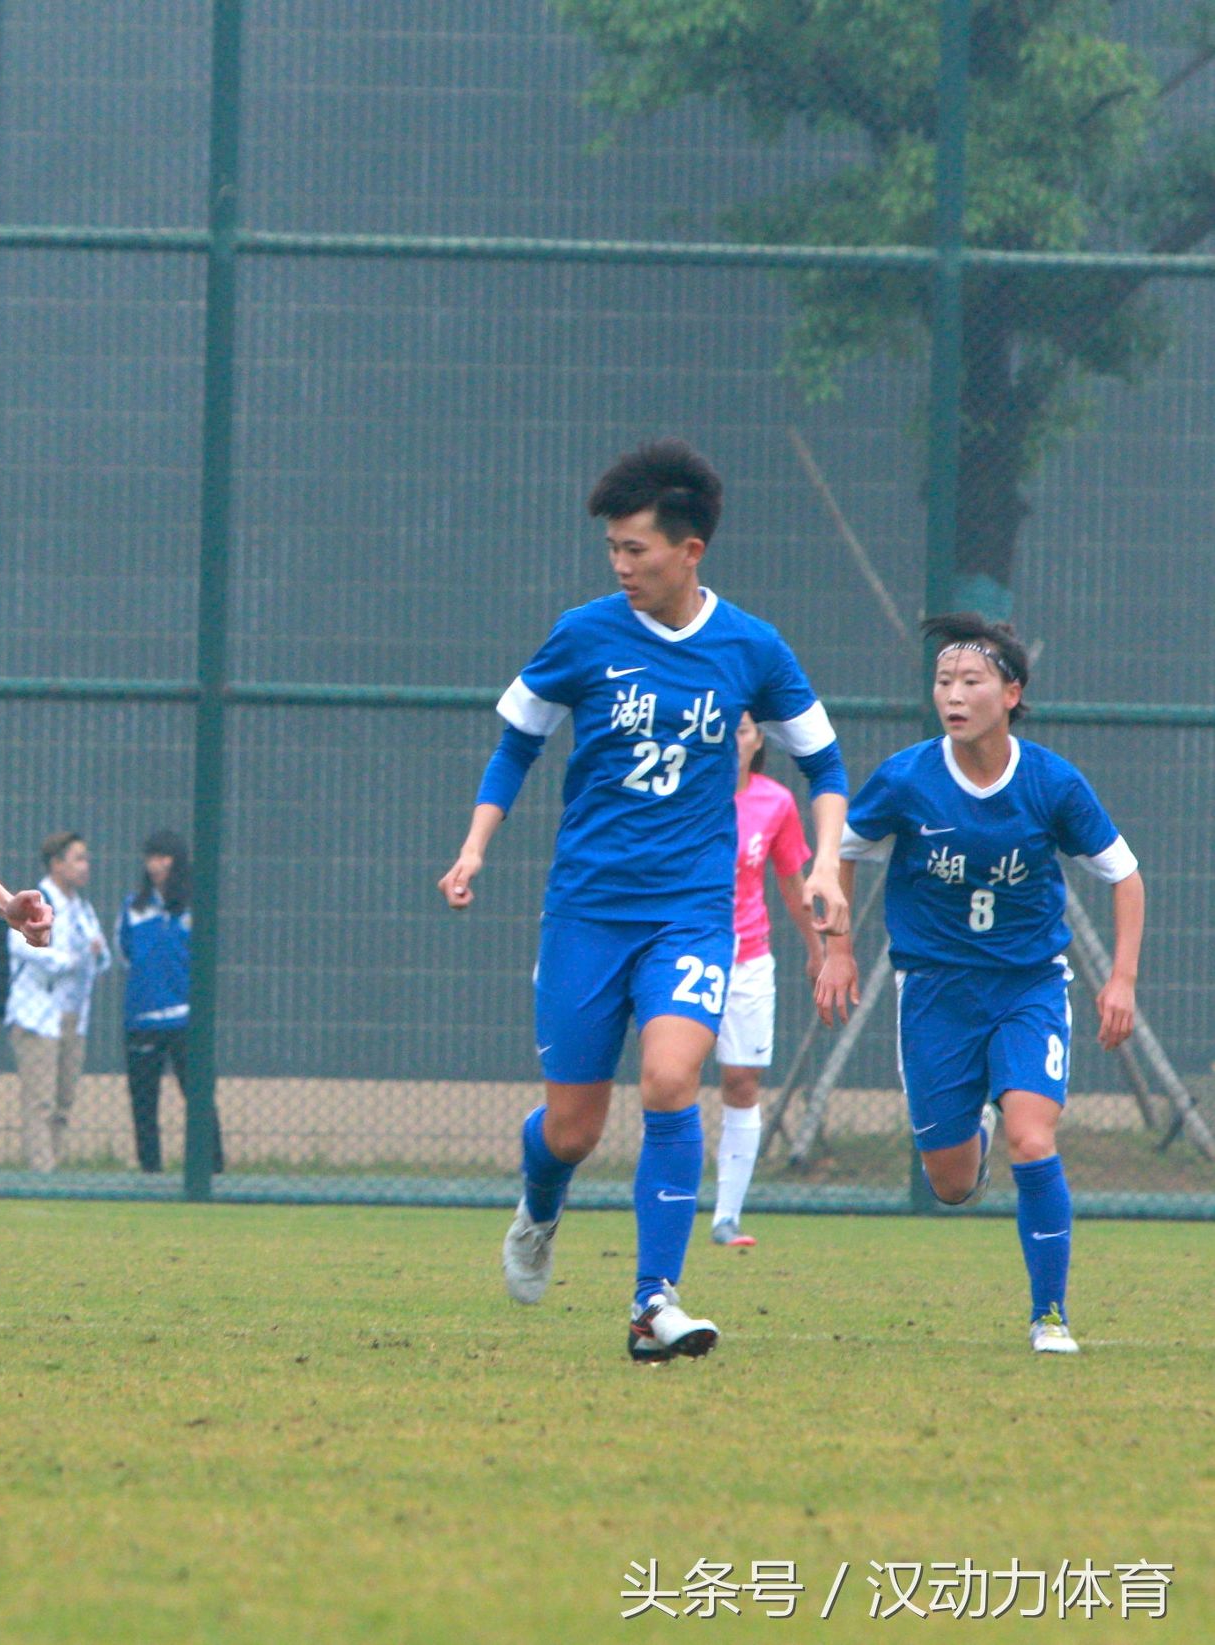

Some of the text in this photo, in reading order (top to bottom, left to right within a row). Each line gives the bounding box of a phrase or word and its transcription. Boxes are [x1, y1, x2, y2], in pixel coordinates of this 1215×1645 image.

[610, 684, 726, 744] 湖北
[621, 741, 687, 796] 23
[927, 846, 1029, 886] 湖北
[969, 889, 995, 932] 8
[672, 955, 725, 1014] 23
[1045, 1034, 1065, 1081] 8
